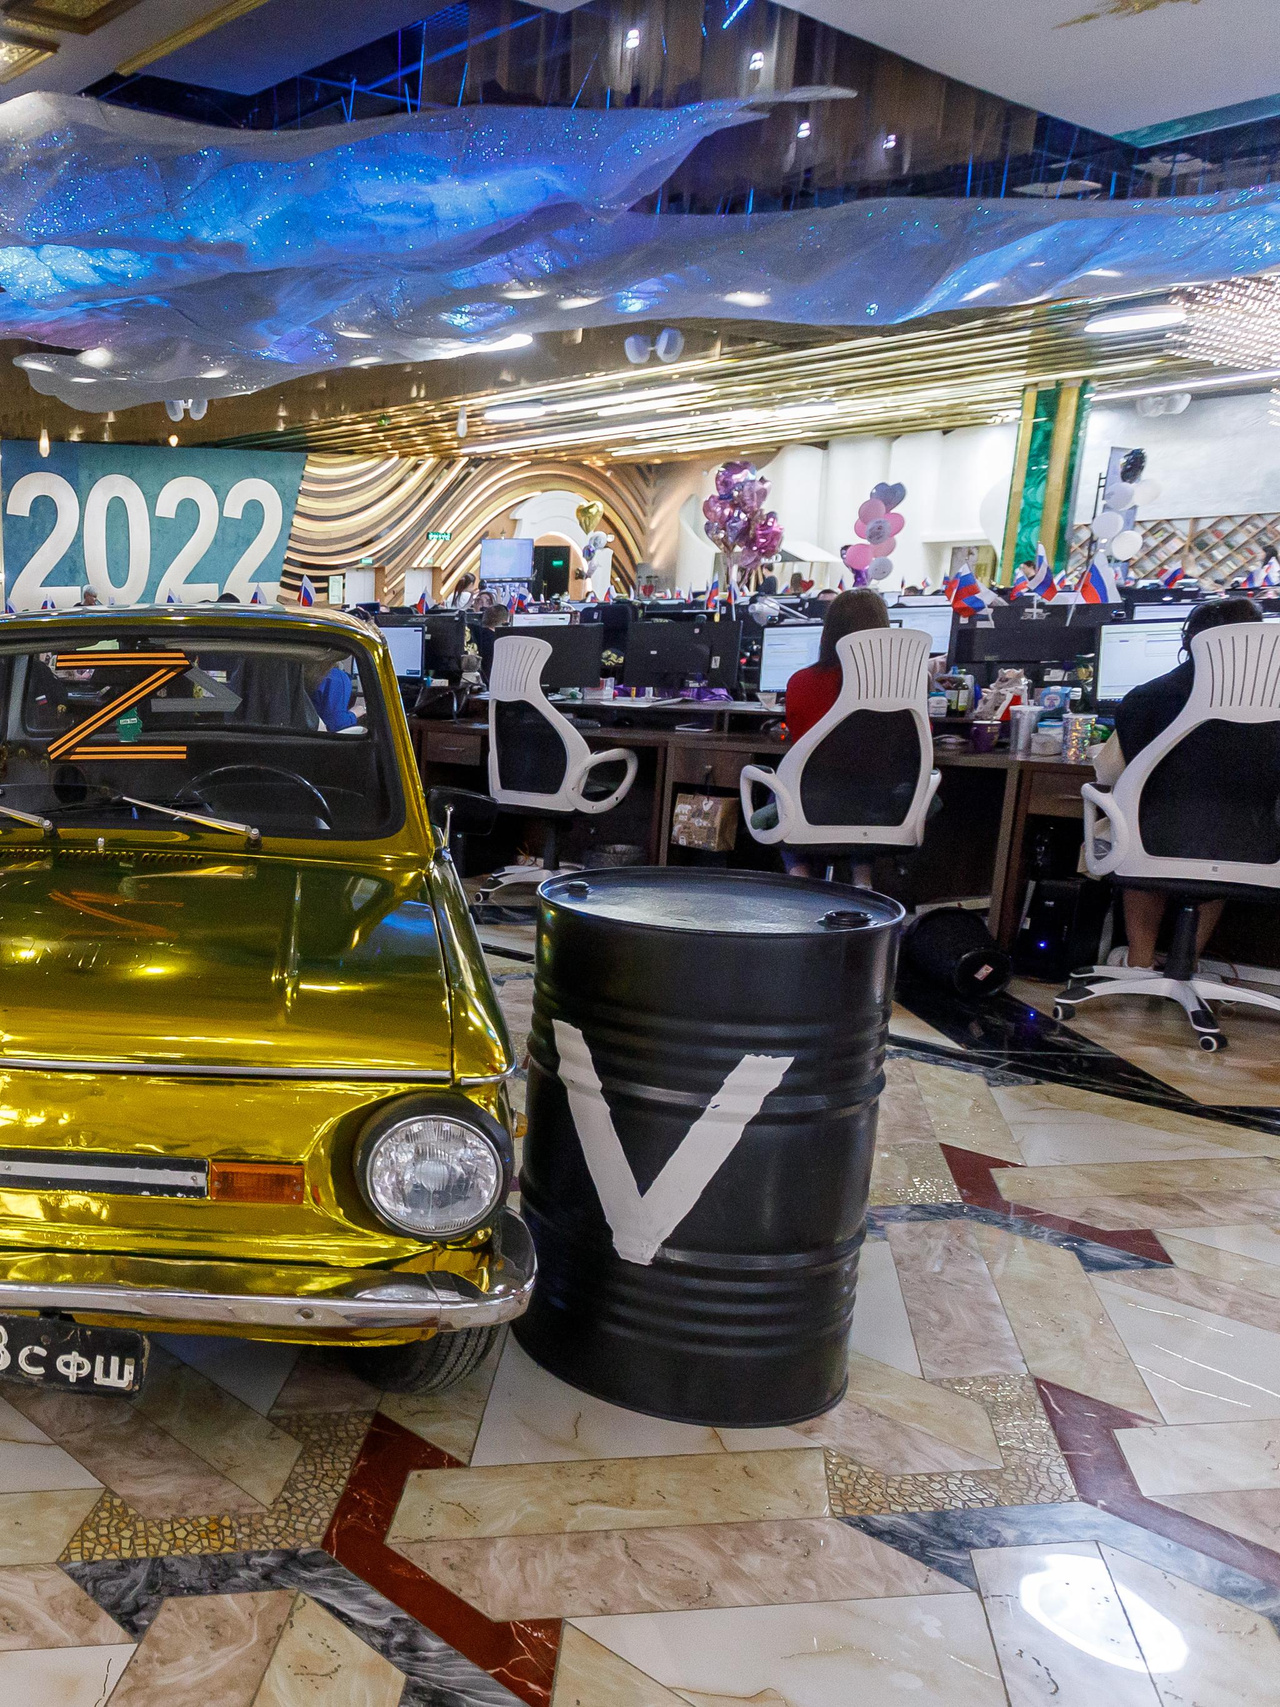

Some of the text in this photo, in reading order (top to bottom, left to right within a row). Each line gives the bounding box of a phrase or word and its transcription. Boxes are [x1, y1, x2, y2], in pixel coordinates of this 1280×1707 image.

[6, 471, 281, 607] 2022
[45, 650, 193, 763] Z
[552, 1018, 795, 1267] V
